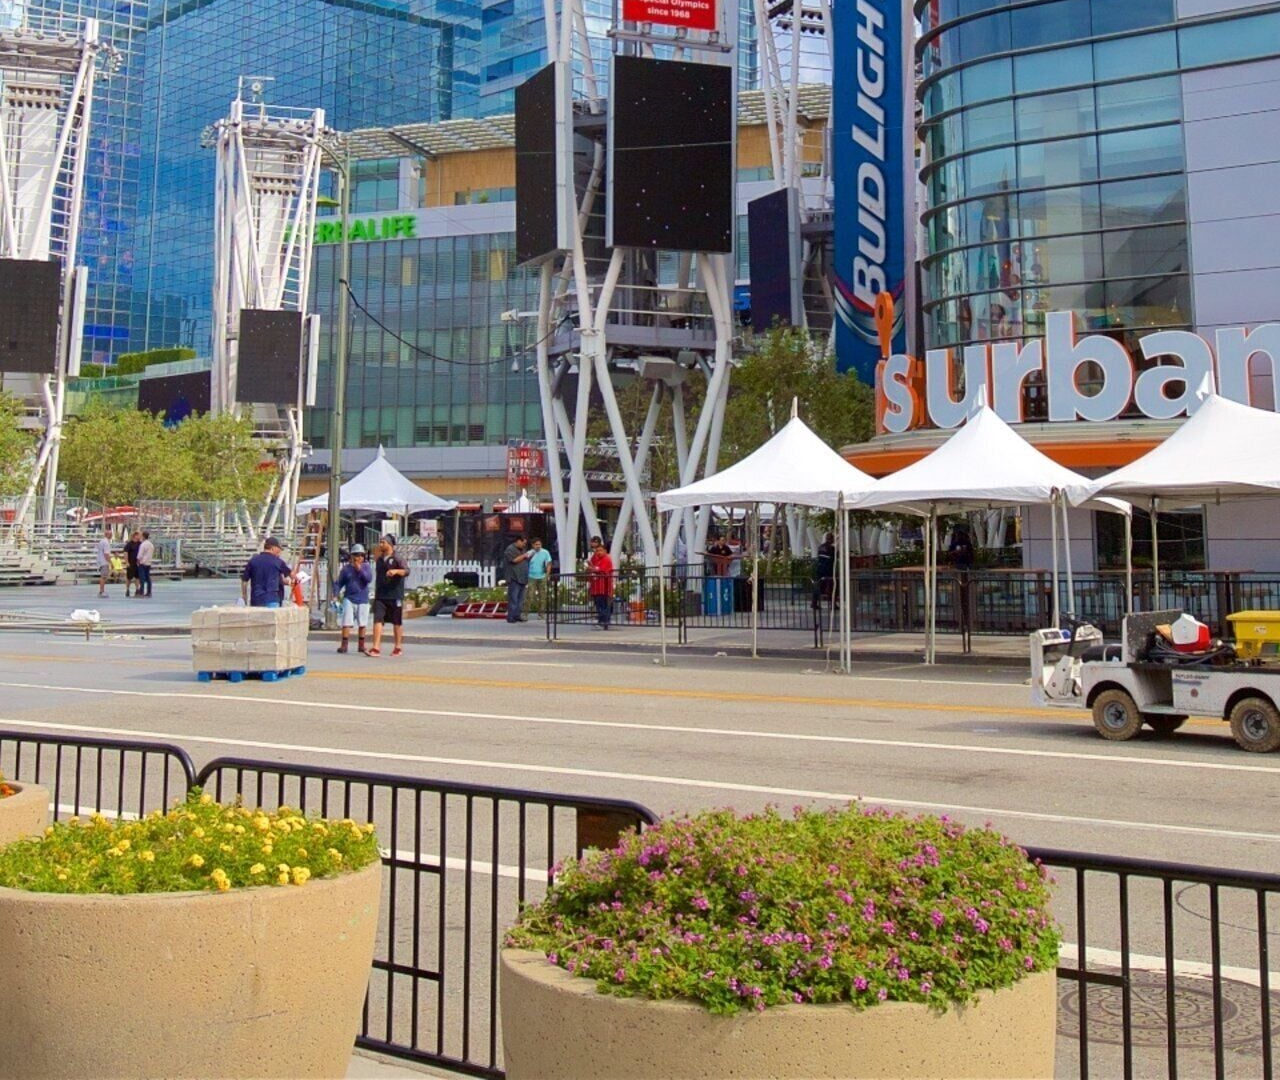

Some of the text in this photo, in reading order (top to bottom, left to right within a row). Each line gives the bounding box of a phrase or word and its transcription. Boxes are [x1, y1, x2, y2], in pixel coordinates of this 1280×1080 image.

[647, 6, 690, 19] since 1968
[283, 213, 417, 243] RBALIFE
[853, 161, 887, 305] BUD
